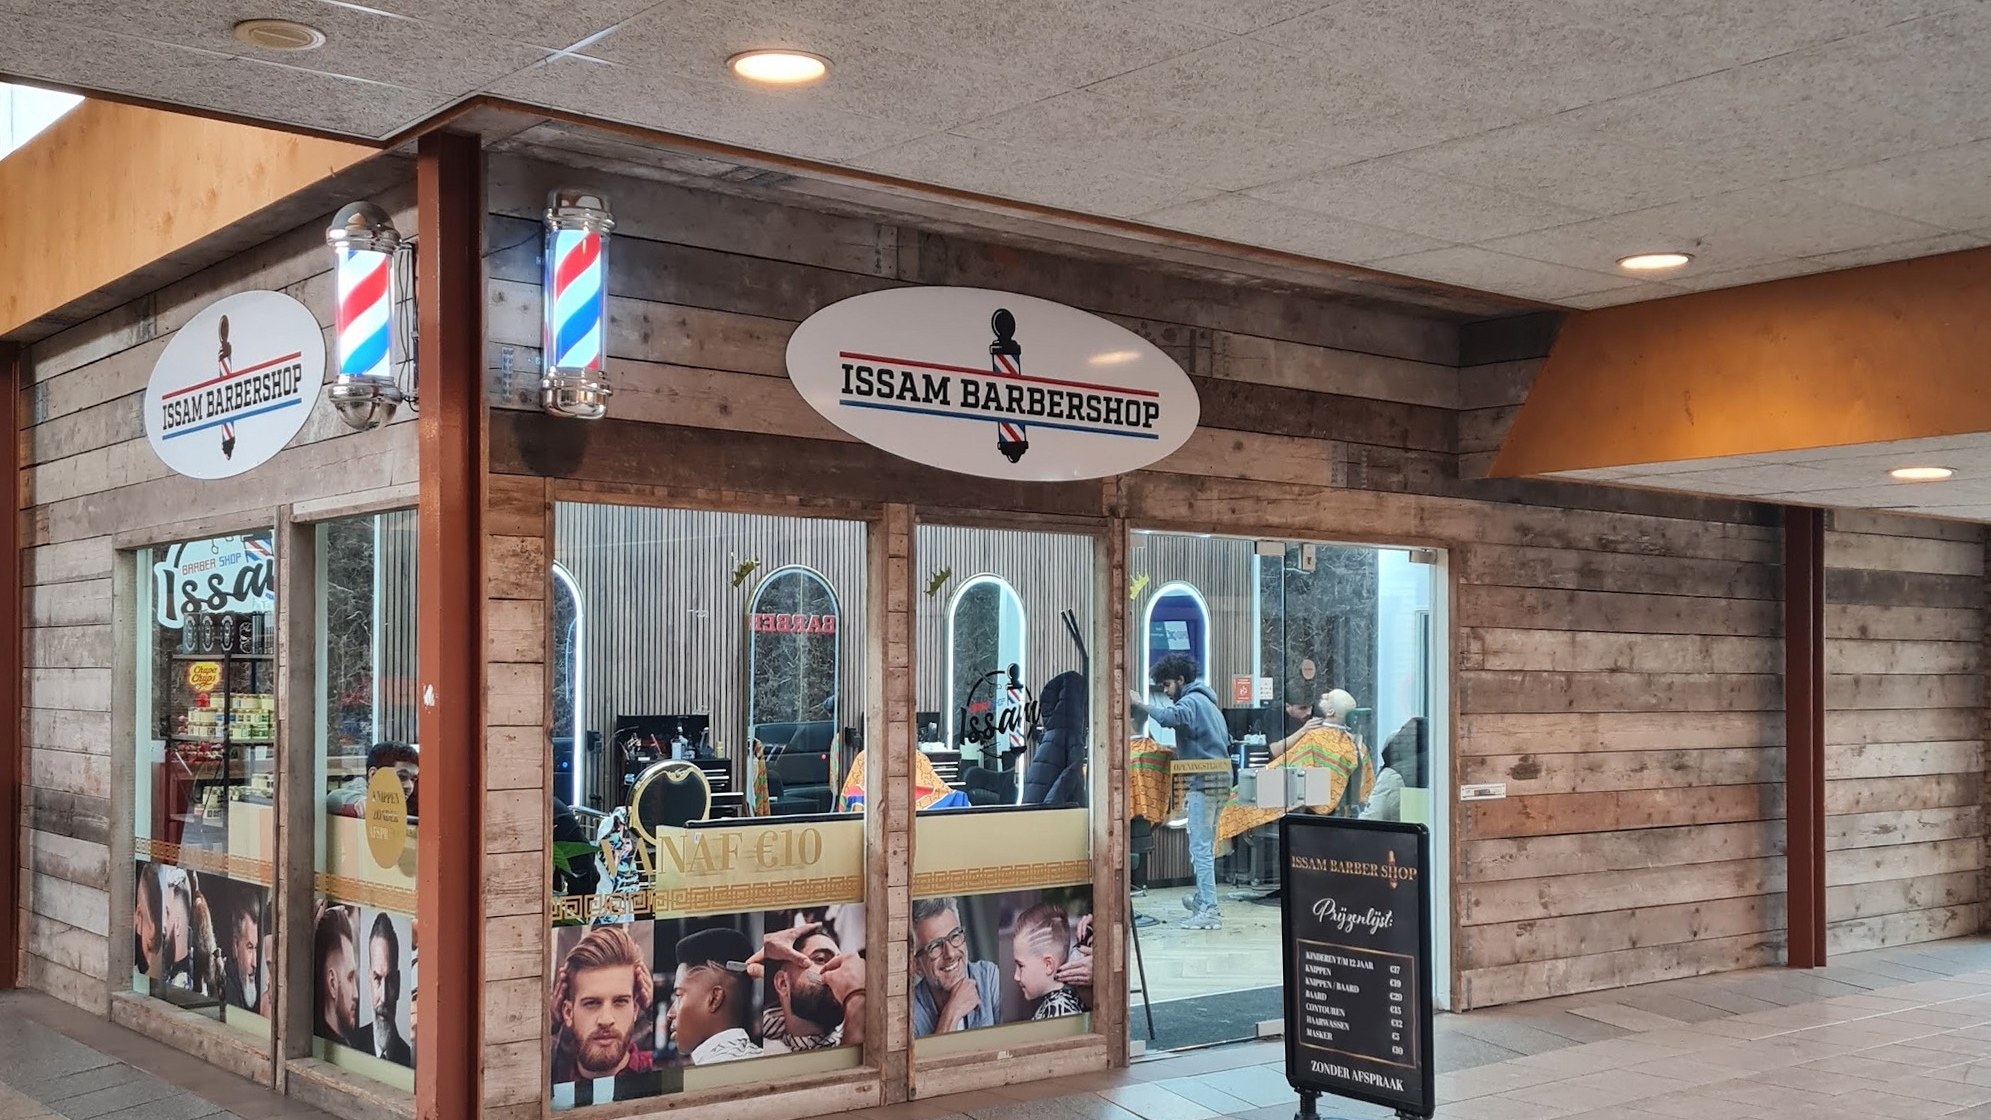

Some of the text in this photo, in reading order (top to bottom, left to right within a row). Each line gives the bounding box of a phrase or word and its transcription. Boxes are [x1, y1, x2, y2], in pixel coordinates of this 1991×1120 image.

[162, 363, 302, 430] ISSAM BARBERSHOP
[841, 363, 1160, 429] ISSAM BARBERSHOP
[182, 552, 242, 576] BARBER SHOP
[600, 827, 823, 877] VANAF €10
[1291, 855, 1418, 880] ISSAM BARBER SHOP
[1305, 951, 1337, 964] KINDEREN
[1305, 964, 1332, 976] KNIPPEN
[1305, 976, 1332, 989] KNIPPEN
[1336, 982, 1360, 993] BAARD
[1305, 989, 1327, 1001] BAARD
[1305, 1002, 1346, 1017] CONTOUREN
[1306, 1015, 1350, 1031] HAARWASSEN
[1306, 1027, 1333, 1041] MASKER
[1311, 1060, 1404, 1092] ZONDER AFSPRAAK
